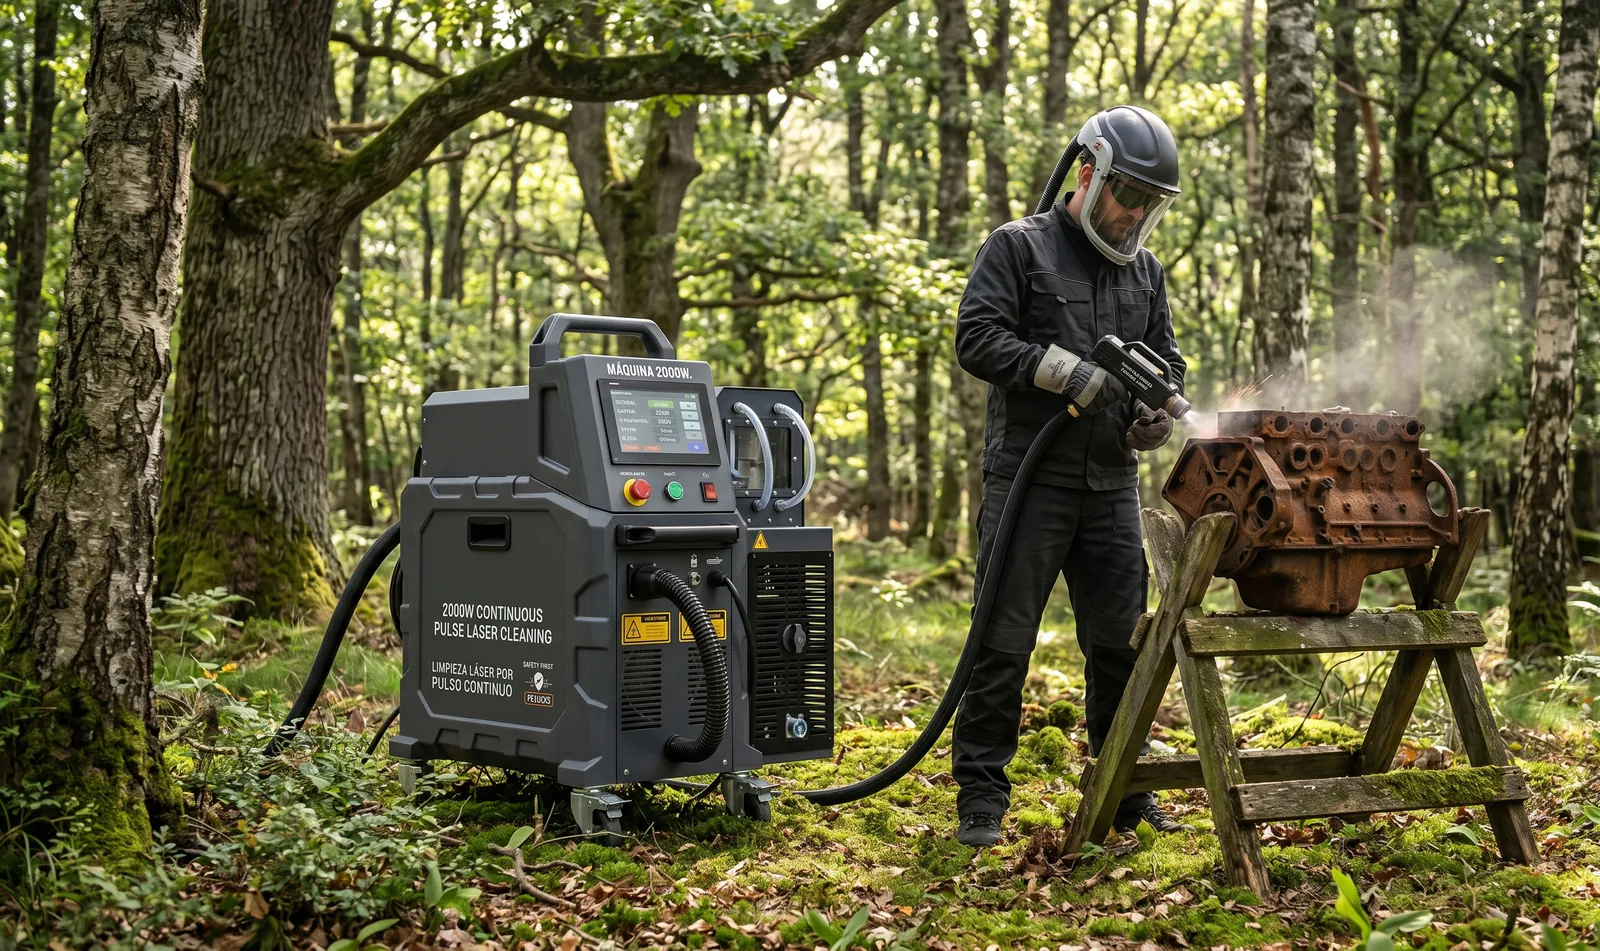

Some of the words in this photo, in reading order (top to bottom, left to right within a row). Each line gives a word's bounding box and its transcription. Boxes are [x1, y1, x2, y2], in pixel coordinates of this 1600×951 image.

[606, 361, 655, 378] MÁQUINA
[655, 366, 693, 379] 2000W.
[442, 602, 474, 619] 2000W
[476, 604, 543, 623] CONTINUOUS
[434, 621, 464, 638] PULSE
[467, 623, 498, 640] LASER
[500, 626, 552, 644] CLEANING
[432, 661, 468, 676] LIMPIEZA
[469, 662, 495, 678] LÁSER
[496, 668, 514, 680] POR
[522, 661, 540, 669] SAFETY
[540, 662, 554, 670] FIRST
[432, 676, 461, 692] PULSO
[464, 679, 513, 697] CONTINUO
